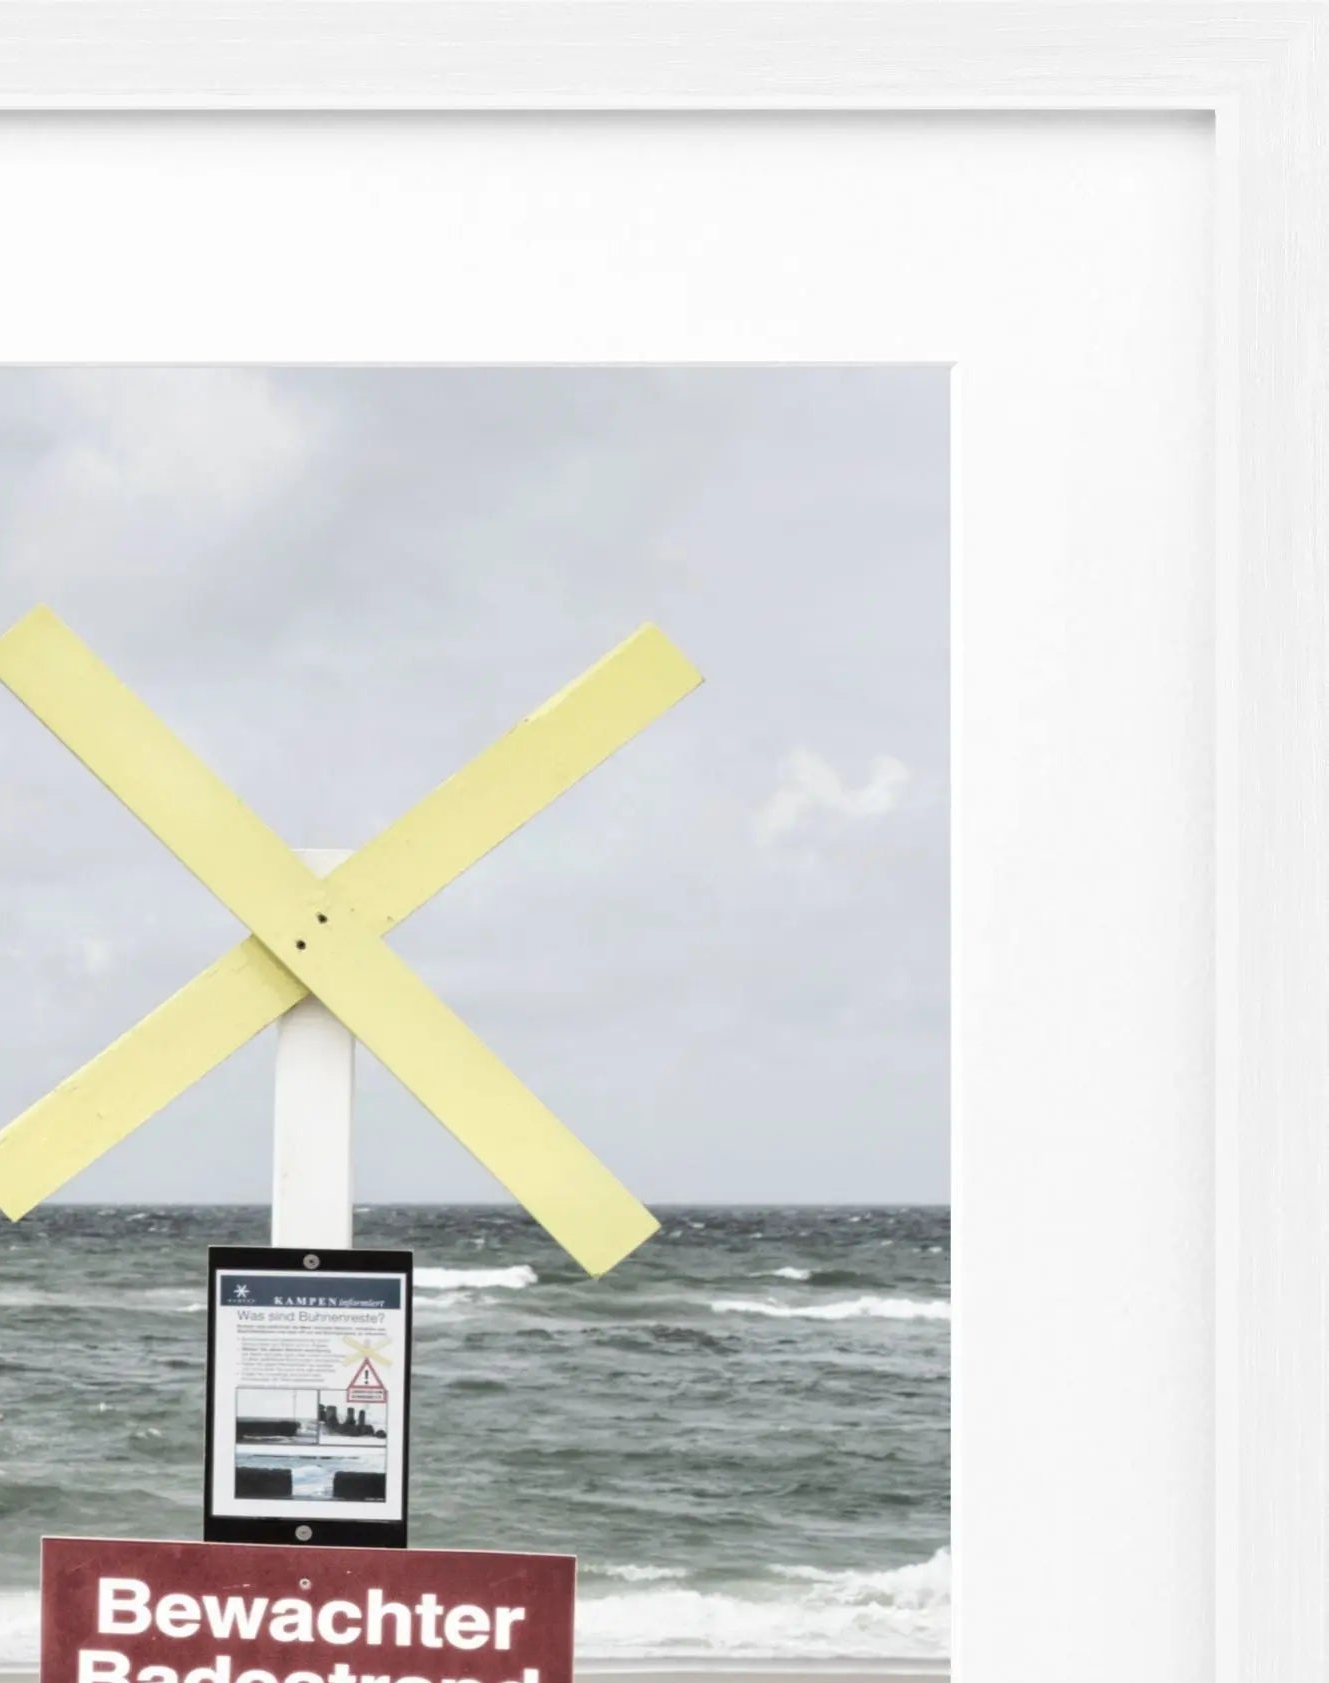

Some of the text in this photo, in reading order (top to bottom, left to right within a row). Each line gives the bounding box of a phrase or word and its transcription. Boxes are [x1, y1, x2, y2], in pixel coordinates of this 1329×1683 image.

[274, 1296, 386, 1309] KAMPEN informiert
[237, 1310, 385, 1324] Was sind Buhnenreste?
[97, 1577, 525, 1650] Bewachter
